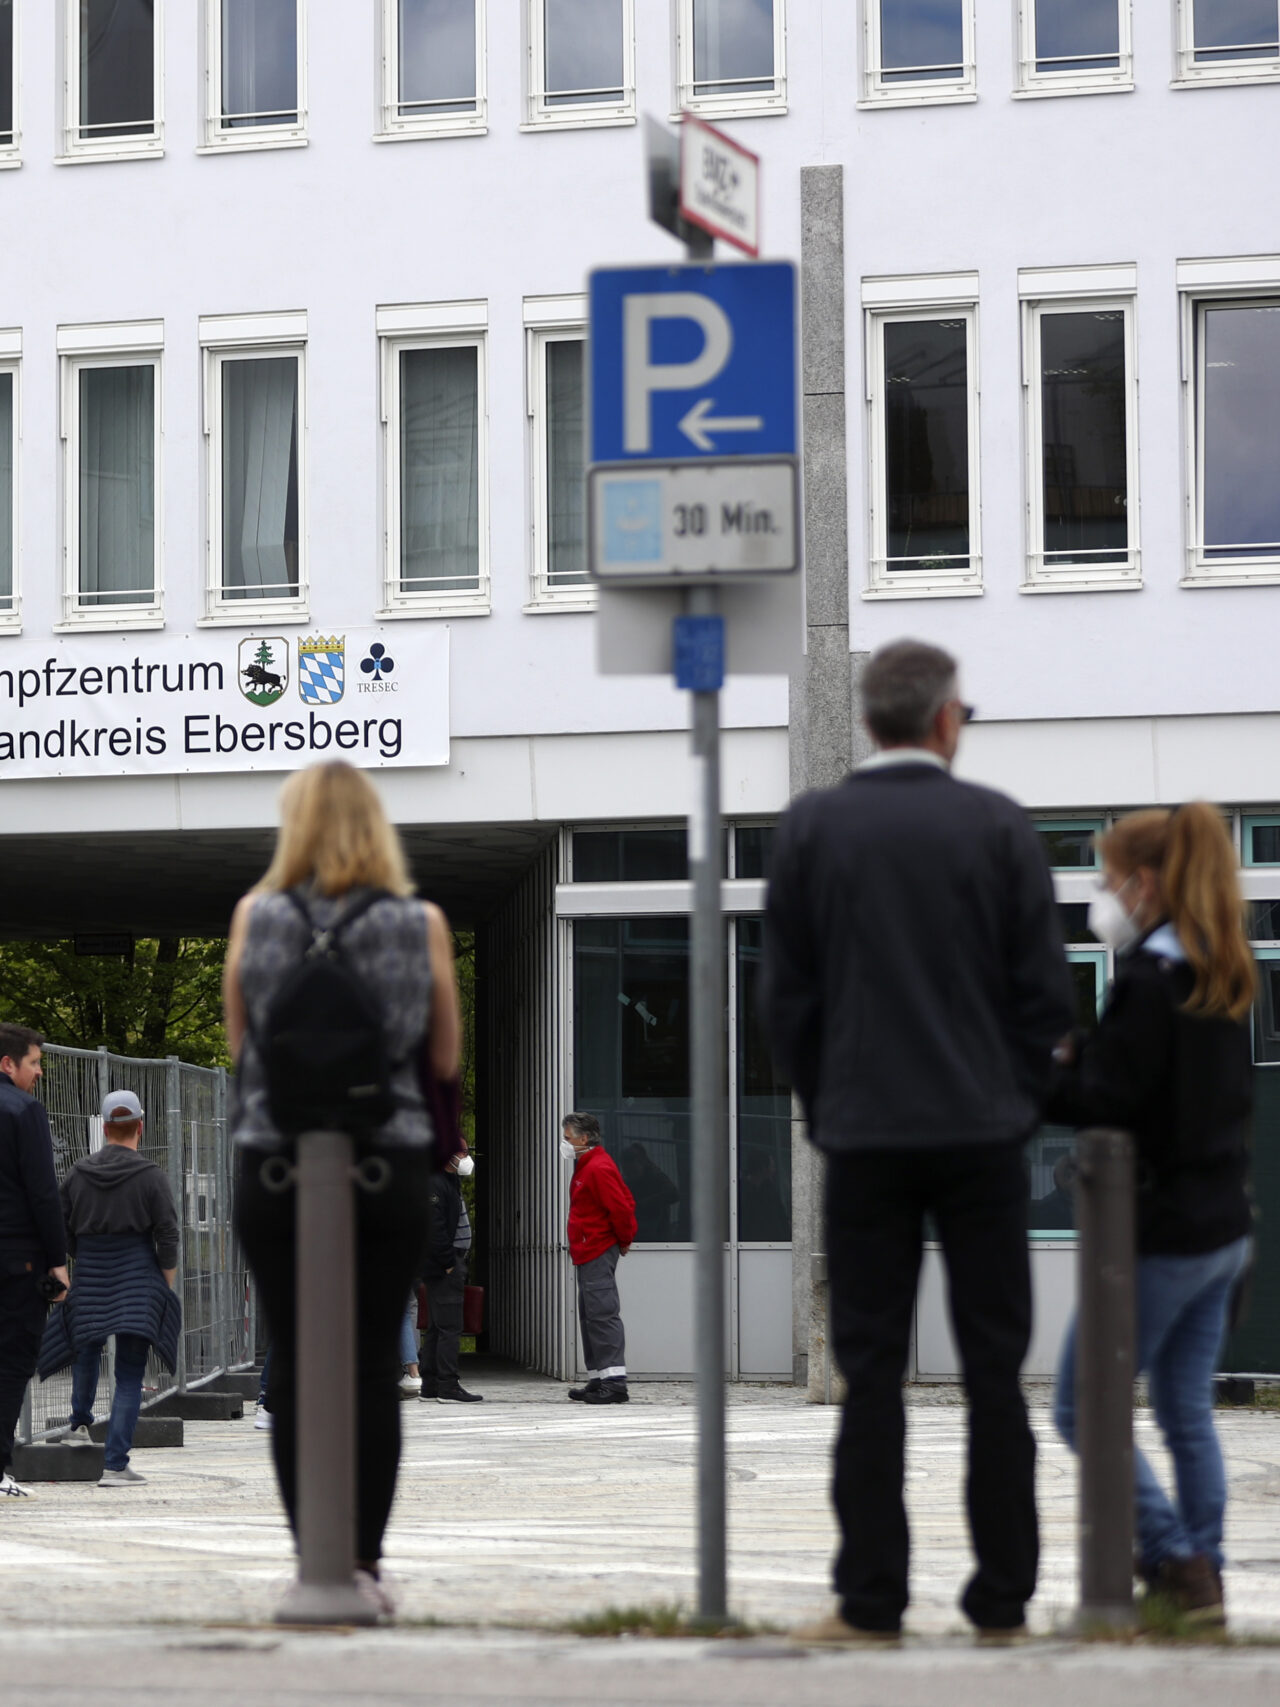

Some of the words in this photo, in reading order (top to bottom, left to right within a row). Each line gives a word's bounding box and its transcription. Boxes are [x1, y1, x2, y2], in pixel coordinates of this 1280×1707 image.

[623, 291, 733, 453] P
[673, 502, 707, 537] 30
[721, 500, 780, 536] Min.
[356, 681, 399, 693] TRESEC
[183, 711, 403, 758] Ebersberg
